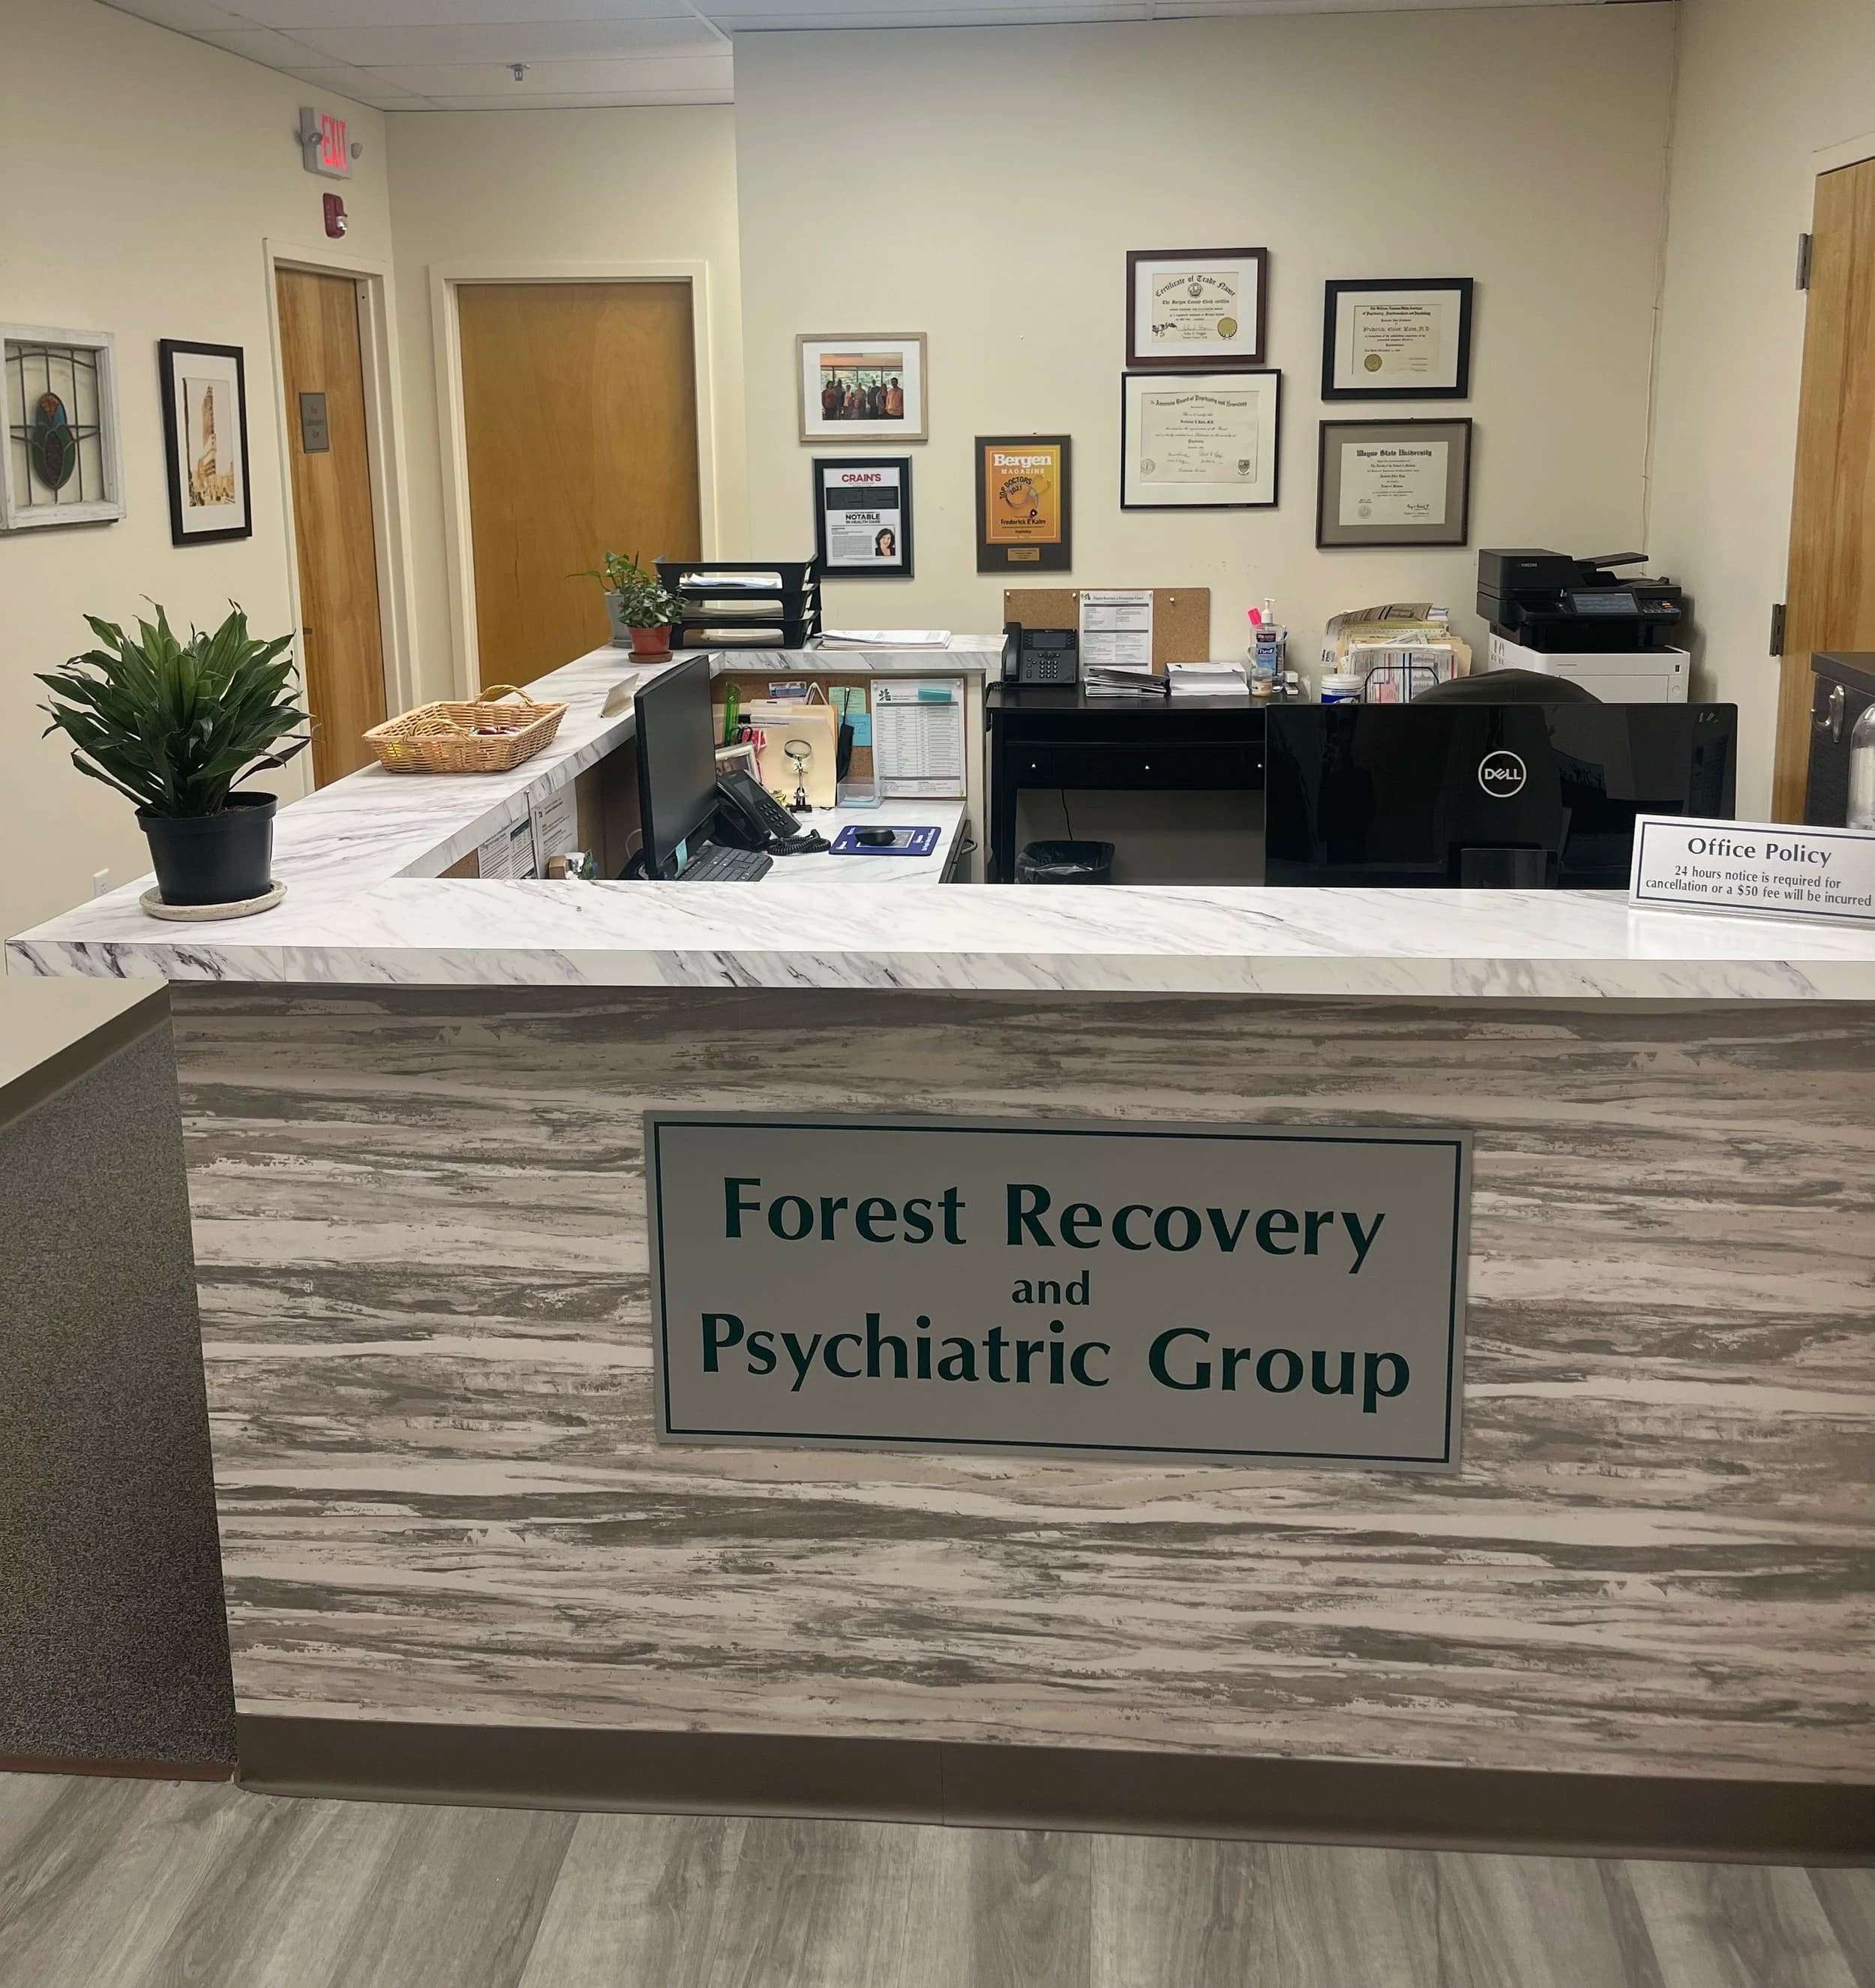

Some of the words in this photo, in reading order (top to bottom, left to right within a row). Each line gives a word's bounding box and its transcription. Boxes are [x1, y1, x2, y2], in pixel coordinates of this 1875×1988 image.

[322, 114, 347, 172] EXIT
[1155, 278, 1185, 297] Certificate
[1188, 275, 1195, 283] of
[1196, 275, 1216, 286] Trade
[1216, 282, 1236, 297] Name
[993, 454, 1052, 468] Bergen
[1399, 449, 1432, 457] University
[842, 473, 882, 482] CRAIN'S
[1004, 476, 1033, 488] DOCTORS
[1010, 485, 1023, 495] 2021
[1484, 767, 1522, 780] DELL
[1688, 837, 1756, 859] Office
[1766, 843, 1832, 869] Policy
[1675, 865, 1688, 876] 24
[1692, 866, 1721, 879] hours
[1725, 871, 1758, 882] notice
[1762, 872, 1769, 883] is
[1773, 875, 1821, 887] required
[1825, 875, 1841, 889] for
[1646, 878, 1708, 893] cancellation
[1712, 884, 1723, 893] or
[1726, 886, 1732, 895] a
[1737, 884, 1758, 897] $50
[1762, 885, 1780, 899] fee
[1784, 888, 1803, 901] will
[1807, 889, 1821, 902] be
[1824, 893, 1872, 906] incurred
[724, 1176, 967, 1245] Forest
[1006, 1183, 1386, 1275] Recovery
[1011, 1269, 1090, 1306] and
[701, 1312, 1111, 1392] Psychiatric
[1148, 1327, 1410, 1414] Group
